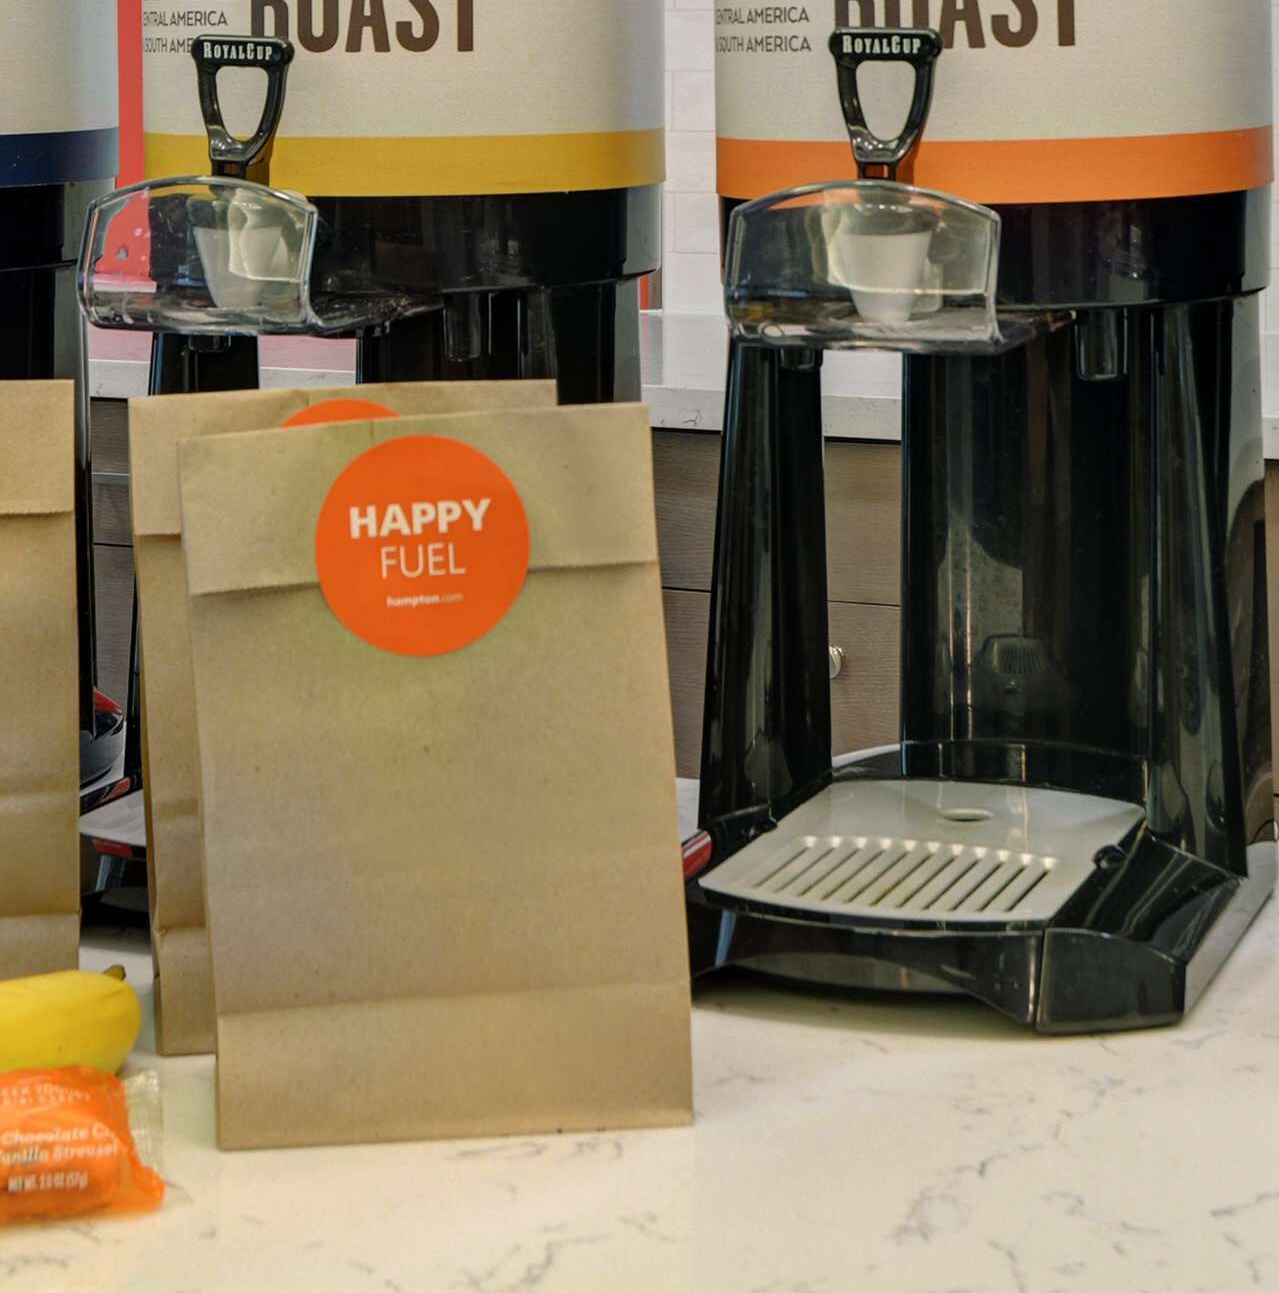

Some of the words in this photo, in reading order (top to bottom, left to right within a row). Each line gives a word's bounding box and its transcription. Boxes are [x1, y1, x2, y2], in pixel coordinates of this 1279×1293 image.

[144, 11, 168, 27] ENTRAL
[170, 10, 228, 26] AMERICA
[716, 8, 745, 24] ENTRAL
[746, 6, 809, 24] AMERICA
[746, 35, 812, 52] AMERICA
[349, 498, 491, 539] HAPPY
[380, 543, 467, 580] FUEL
